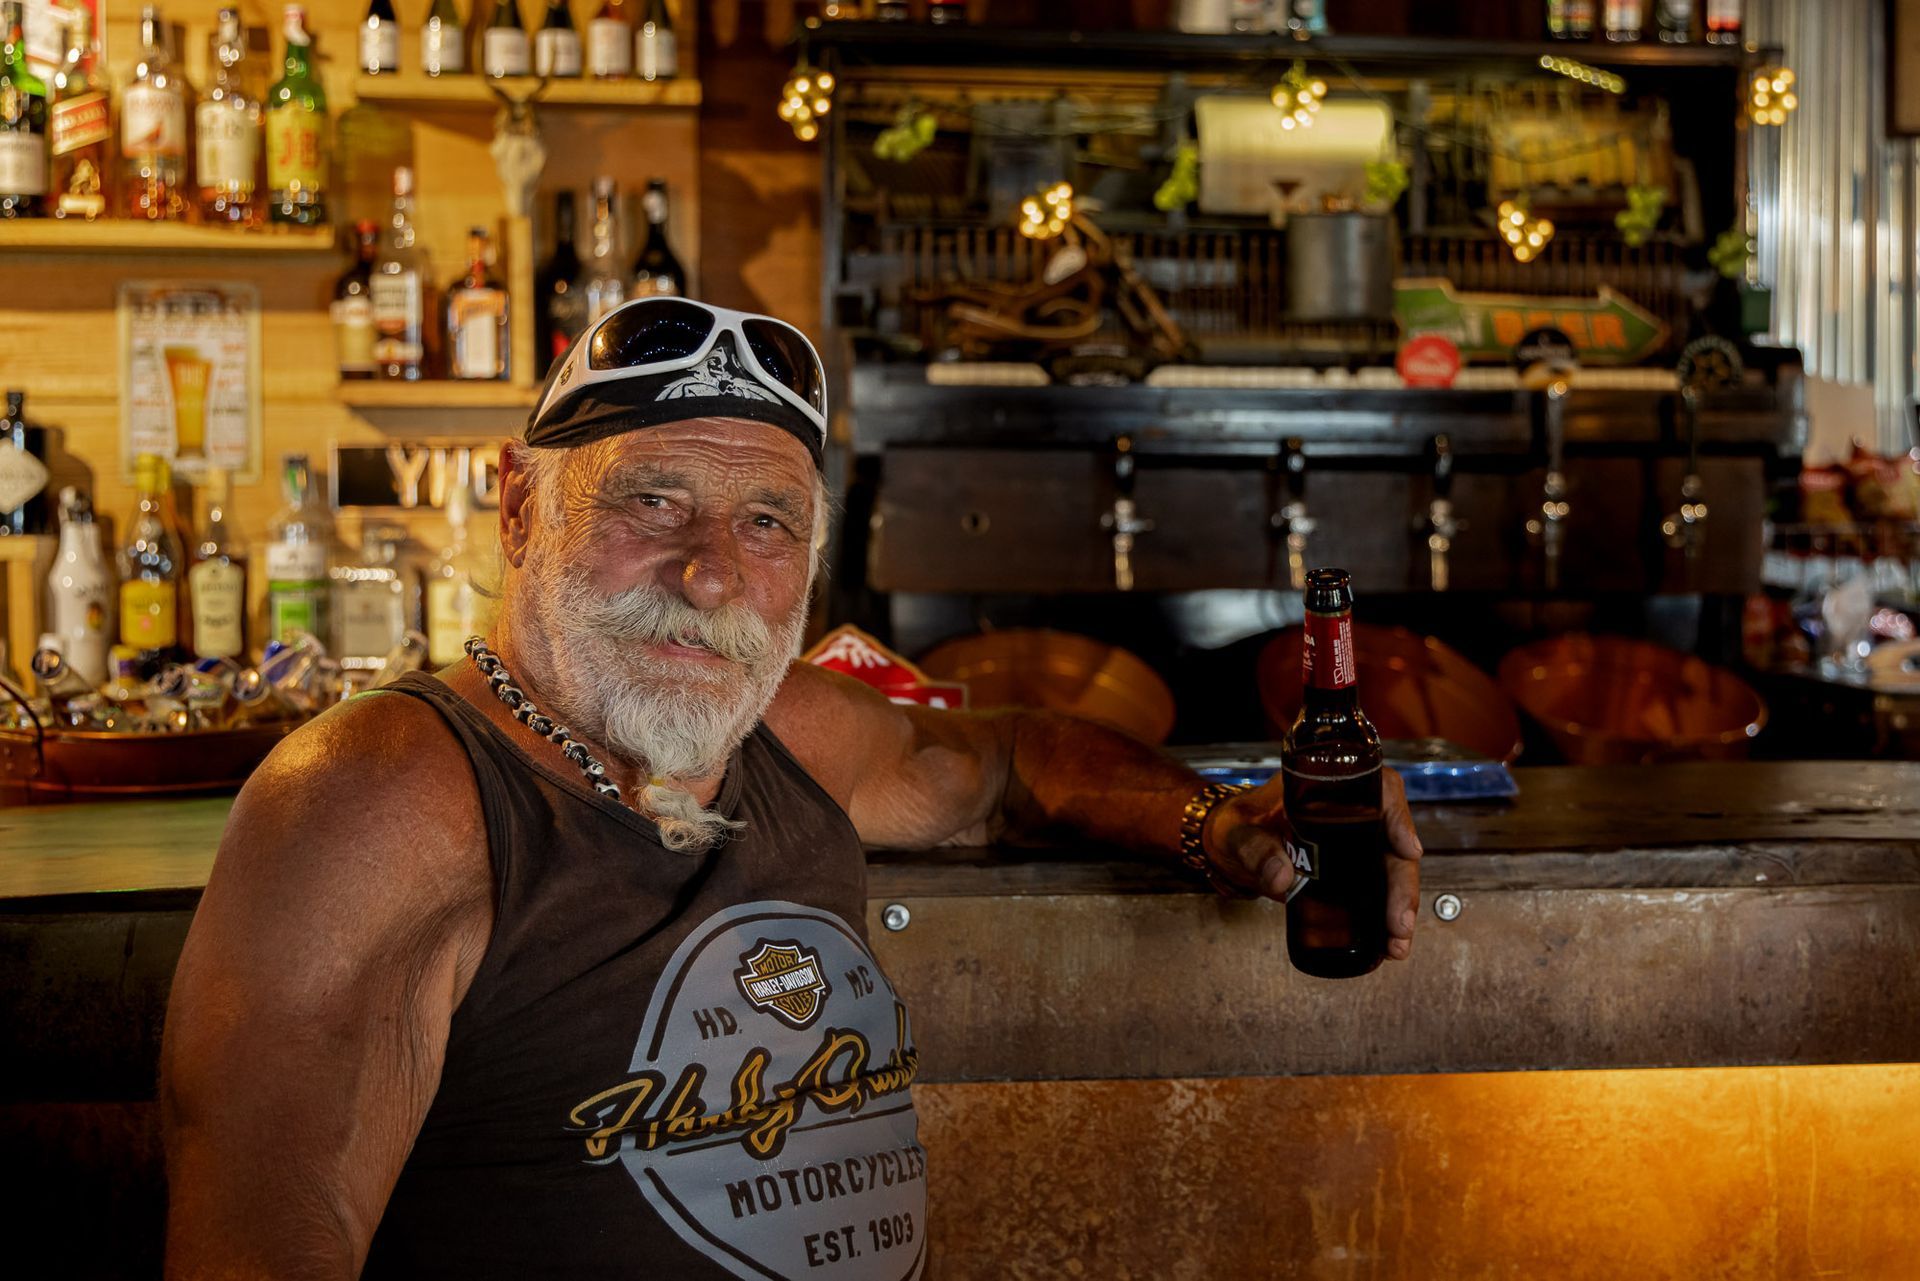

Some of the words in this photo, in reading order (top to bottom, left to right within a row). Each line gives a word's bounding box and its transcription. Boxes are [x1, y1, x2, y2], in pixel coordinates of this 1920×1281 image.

[760, 952, 796, 976] MOTOR
[750, 965, 817, 999] HARLEY-DAVIDSON
[844, 965, 874, 1000] MC
[778, 990, 813, 1014] CYCLES
[724, 1146, 924, 1219] MOTORCYCLES
[803, 1225, 861, 1268] EST.
[868, 1212, 915, 1252] 1903
